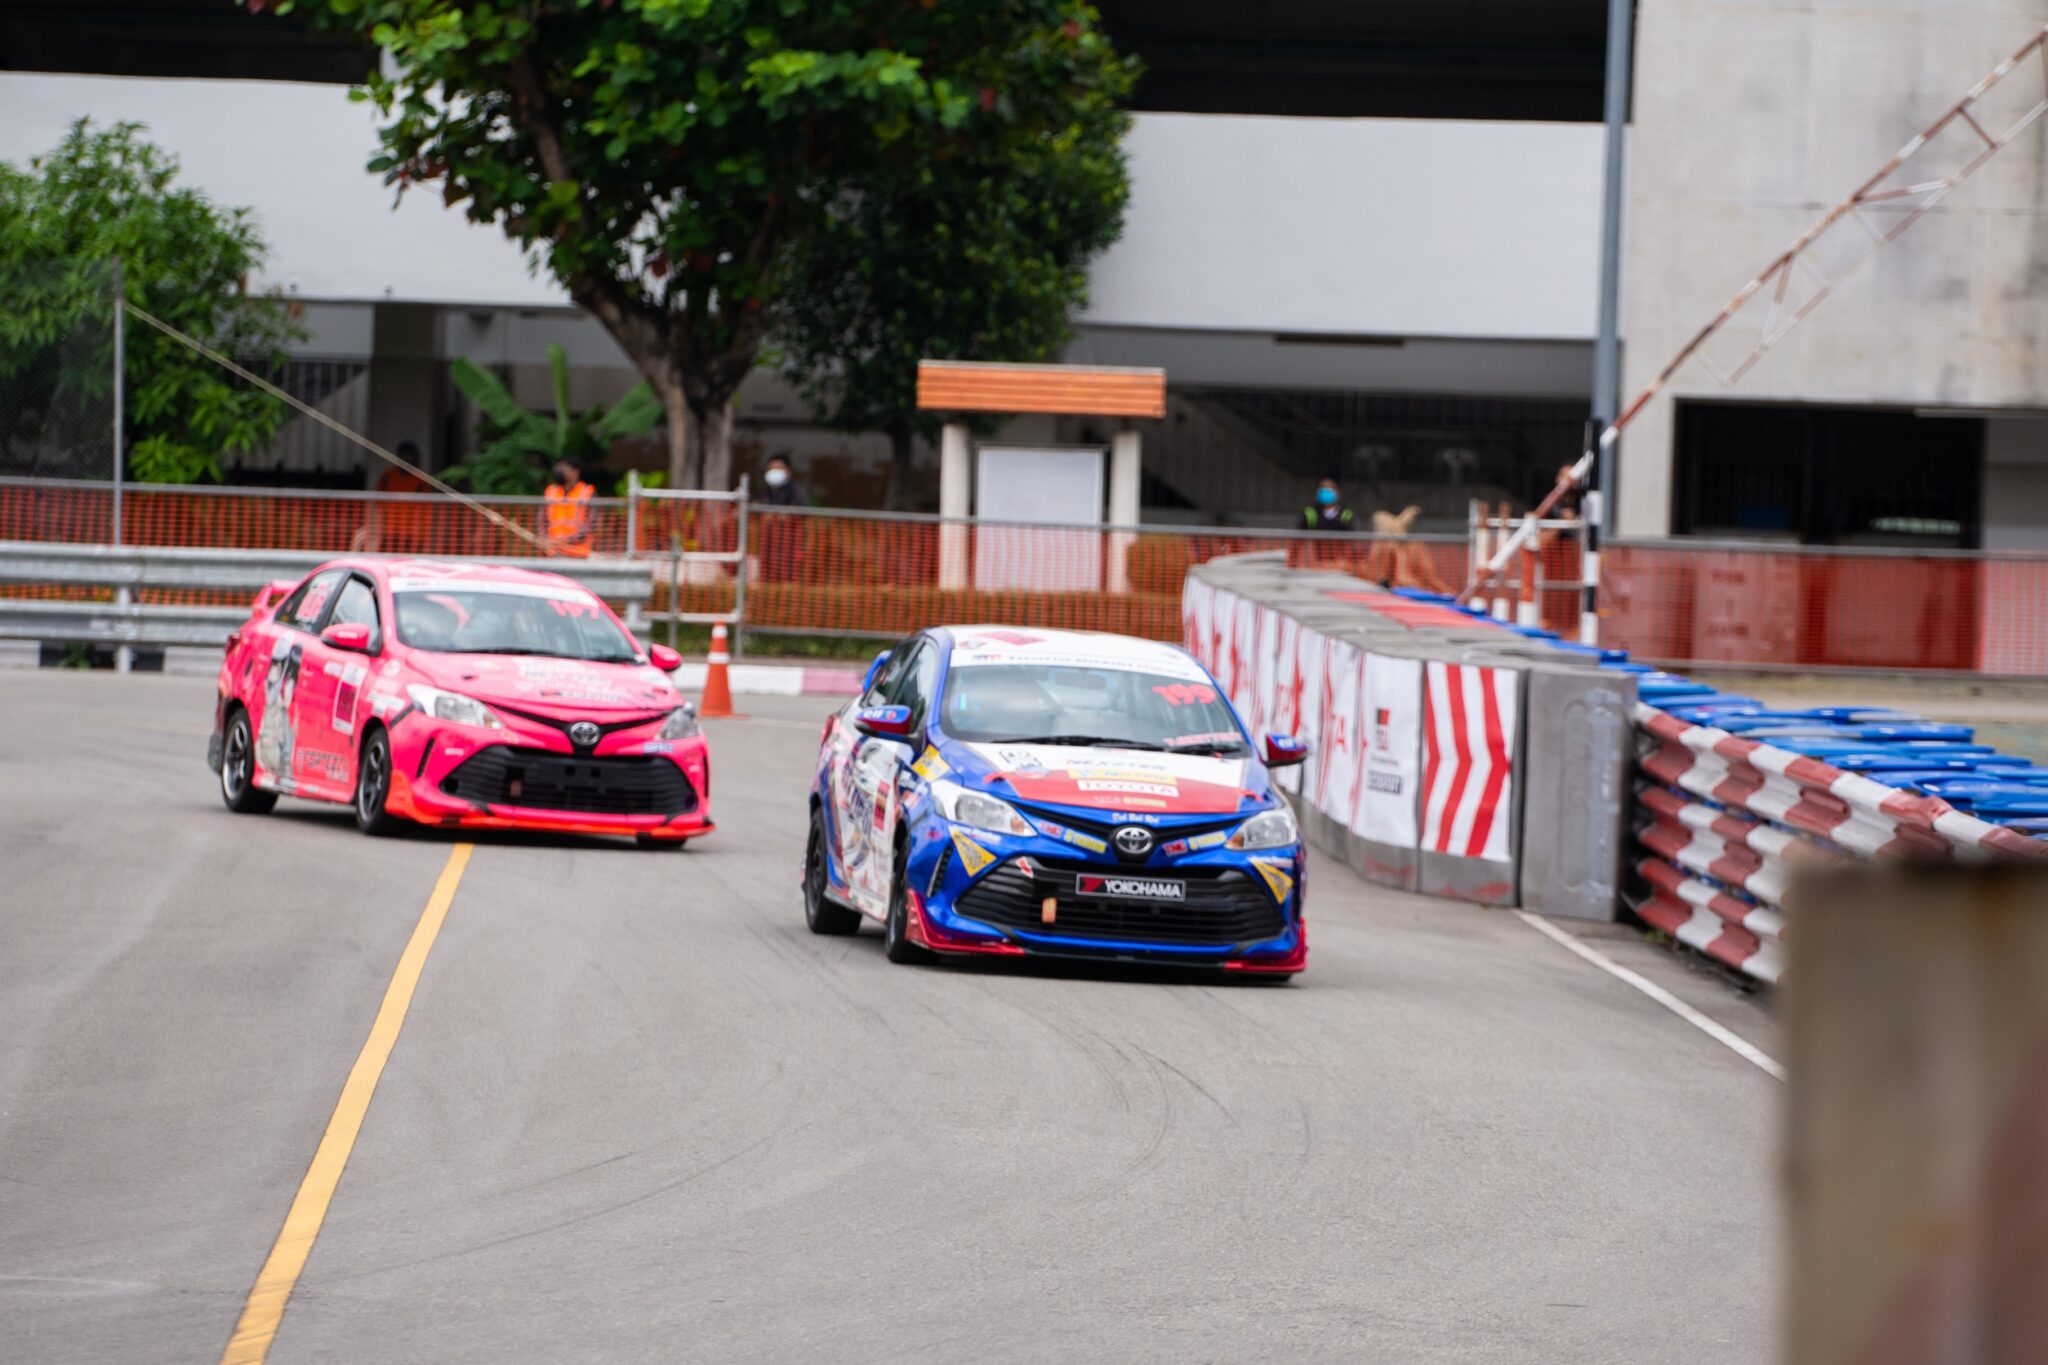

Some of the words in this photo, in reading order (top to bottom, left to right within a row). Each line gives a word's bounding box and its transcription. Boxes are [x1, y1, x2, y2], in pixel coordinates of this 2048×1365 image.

[1152, 683, 1217, 706] 199
[863, 709, 884, 718] elf
[1083, 781, 1175, 796] TOYOTA
[1103, 879, 1182, 898] YOKOHAMA
